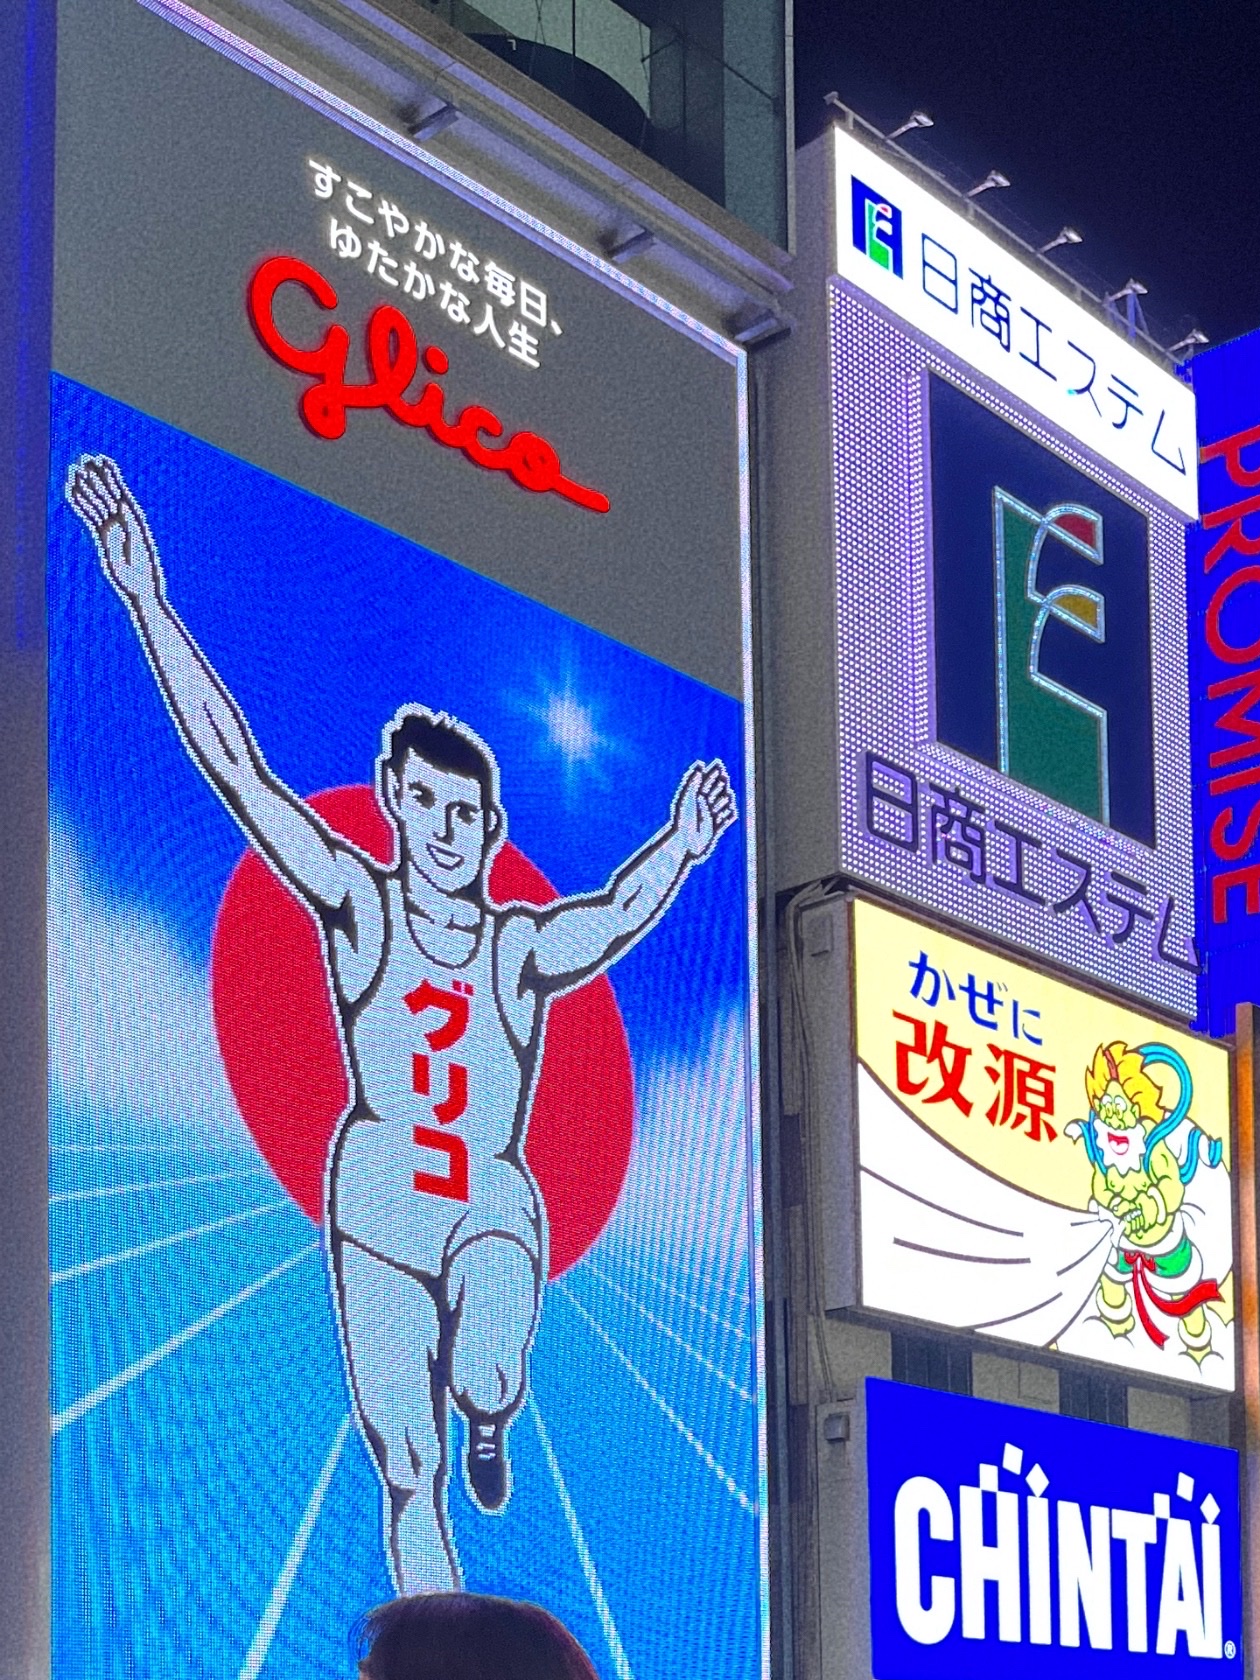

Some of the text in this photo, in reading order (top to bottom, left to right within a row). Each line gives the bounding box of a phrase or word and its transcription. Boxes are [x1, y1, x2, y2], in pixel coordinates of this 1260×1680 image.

[308, 157, 563, 337] すこやかな毎日、
[330, 218, 540, 368] ゆたかな人生
[249, 255, 610, 513] Glico
[921, 231, 1187, 476] 日商エステム
[865, 749, 1200, 974] 日商エステム
[403, 978, 474, 1203] グリコ
[892, 1008, 1059, 1143] 改源
[908, 950, 1043, 1046] かぜに
